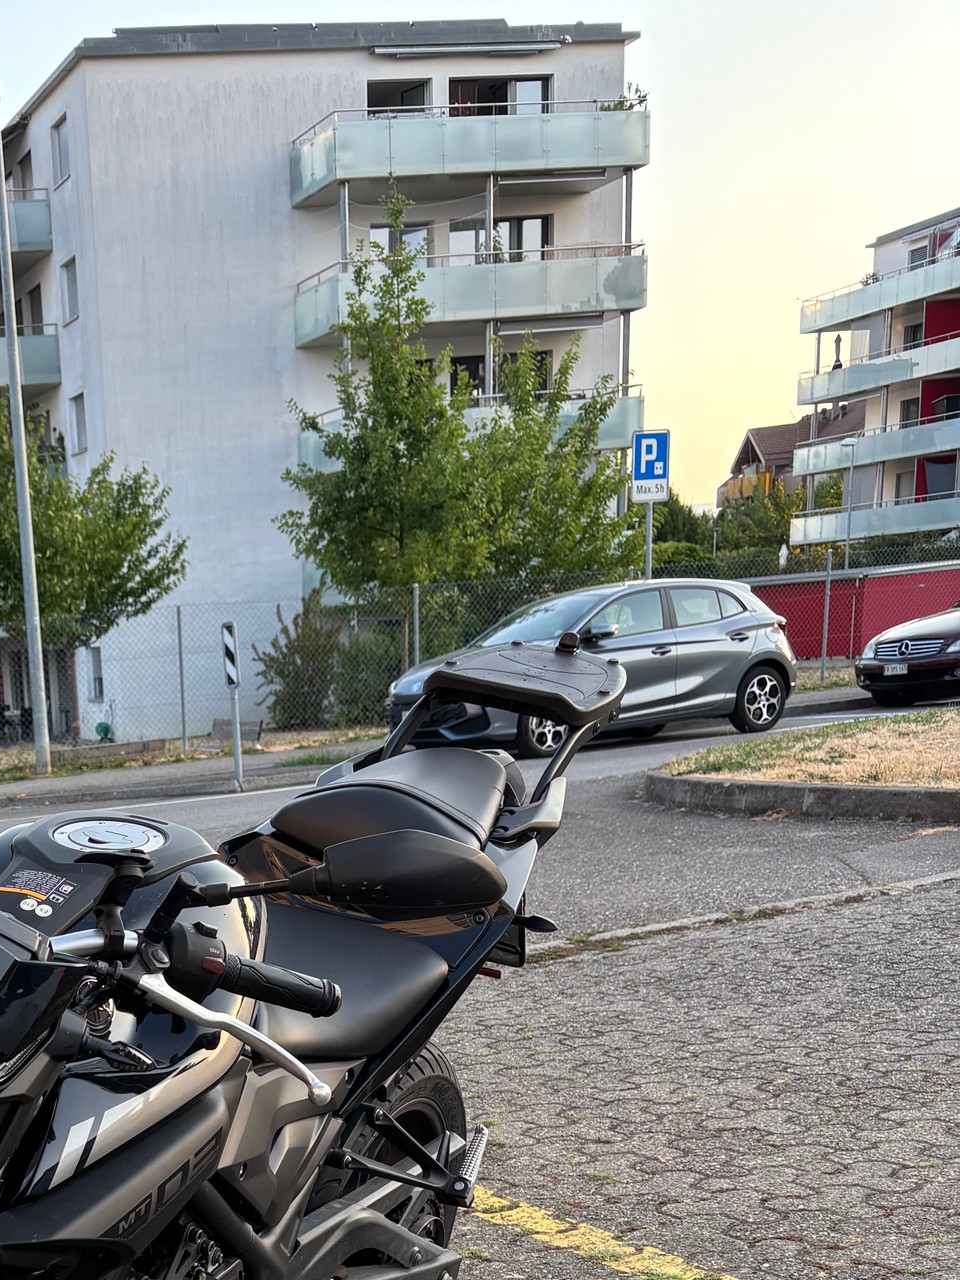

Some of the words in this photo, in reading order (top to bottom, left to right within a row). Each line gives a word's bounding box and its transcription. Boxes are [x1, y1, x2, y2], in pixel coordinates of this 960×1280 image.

[640, 438, 658, 474] P
[636, 484, 654, 495] Max.
[655, 483, 665, 494] 5h
[118, 1198, 151, 1235] MT
